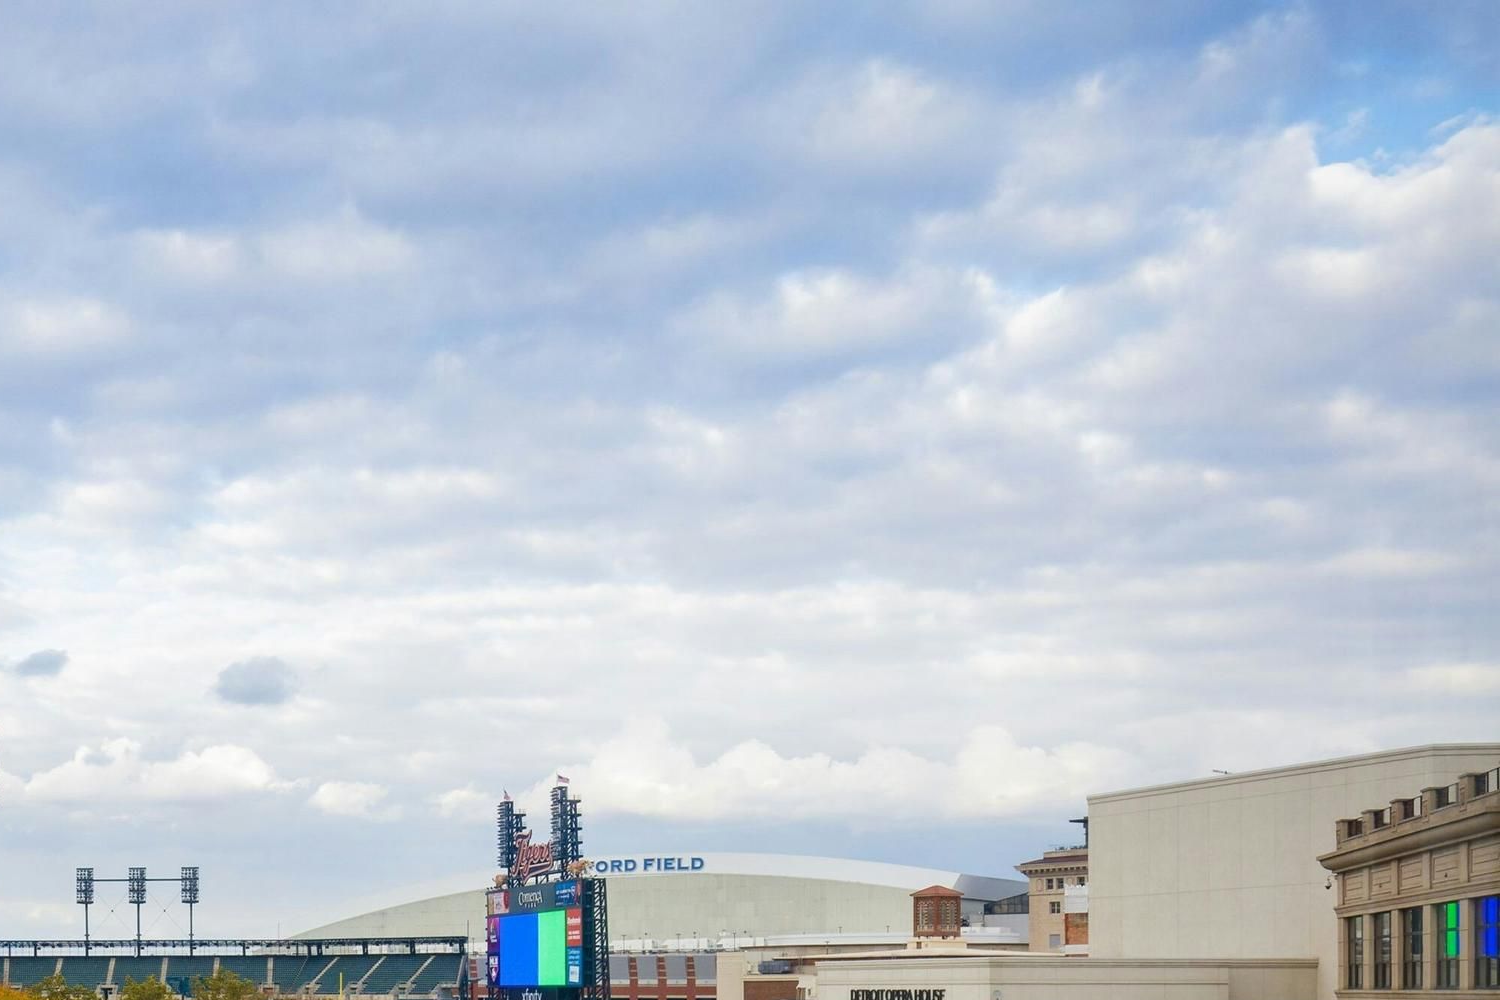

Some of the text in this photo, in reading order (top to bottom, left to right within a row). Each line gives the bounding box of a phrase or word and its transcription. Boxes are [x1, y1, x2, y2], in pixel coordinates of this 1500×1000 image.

[511, 829, 553, 884] Tigers
[591, 857, 705, 873] ORD FIELD
